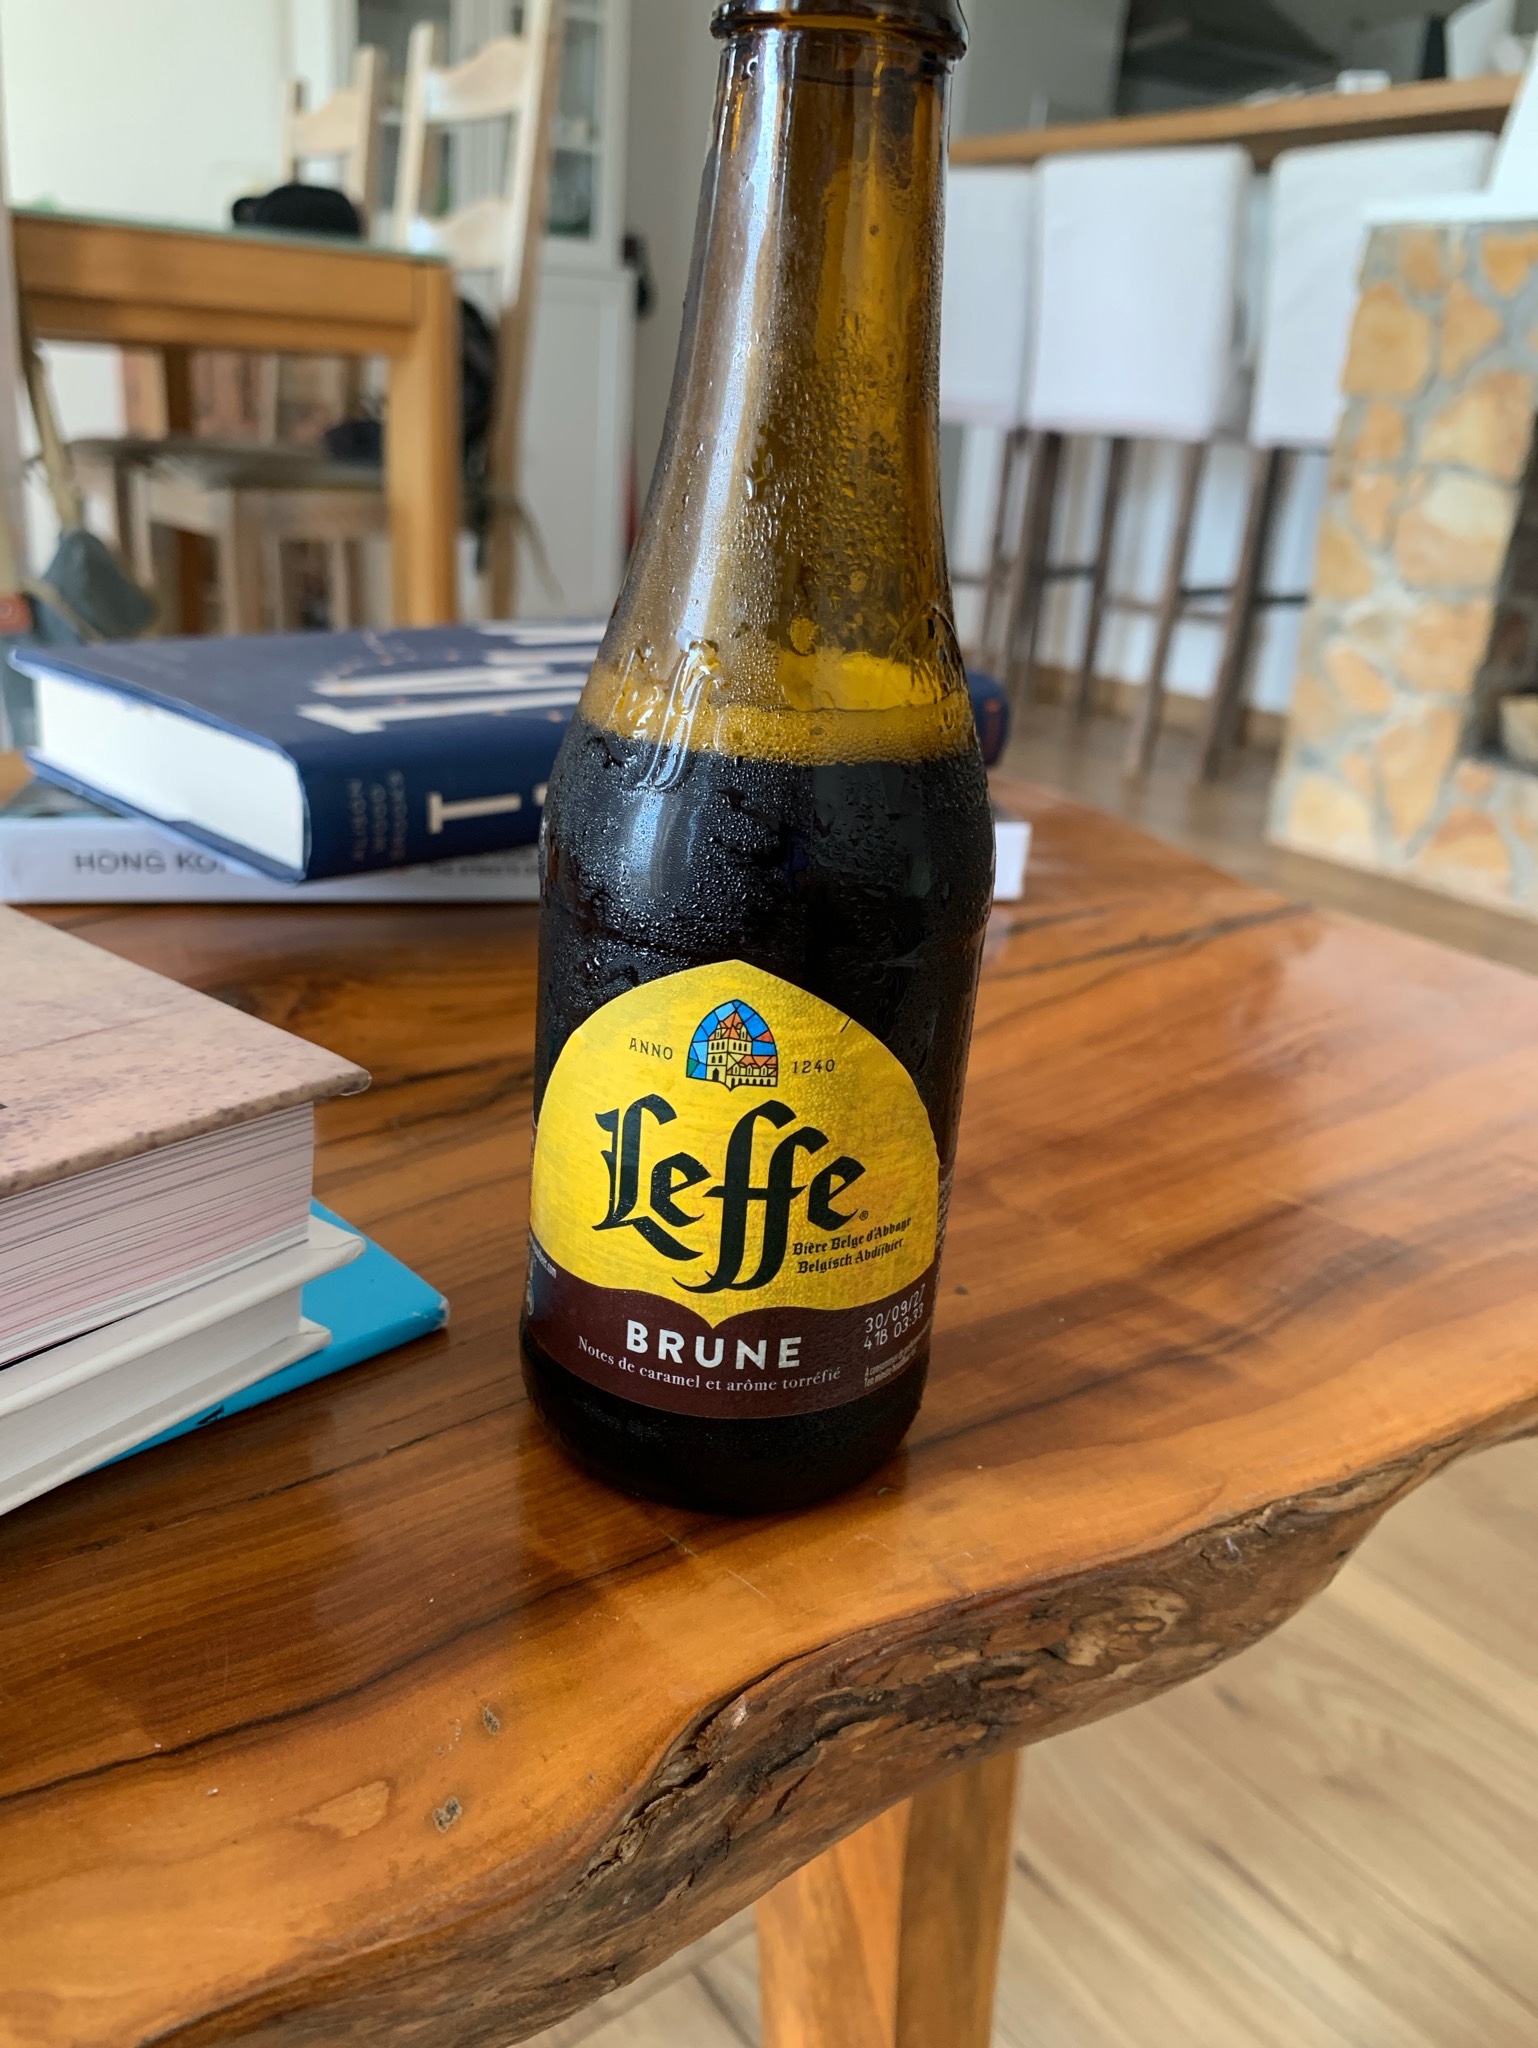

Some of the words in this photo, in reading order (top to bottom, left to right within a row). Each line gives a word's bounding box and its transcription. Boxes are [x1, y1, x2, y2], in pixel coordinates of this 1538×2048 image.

[75, 850, 166, 875] HONG
[629, 1037, 674, 1060] ANNO
[792, 1058, 836, 1074] 1240
[592, 1093, 866, 1293] Leffe
[792, 1242, 828, 1256] Bière
[831, 1234, 865, 1251] Belge
[797, 1251, 853, 1274] Belgisch
[855, 1238, 904, 1264] Abdijbier
[626, 1319, 802, 1370] BRUNE
[578, 1335, 615, 1365] Notes
[618, 1357, 635, 1373] de
[639, 1366, 700, 1388] caramel
[706, 1379, 721, 1391] et
[727, 1378, 777, 1391] arôme
[782, 1366, 841, 1391] torréfié
